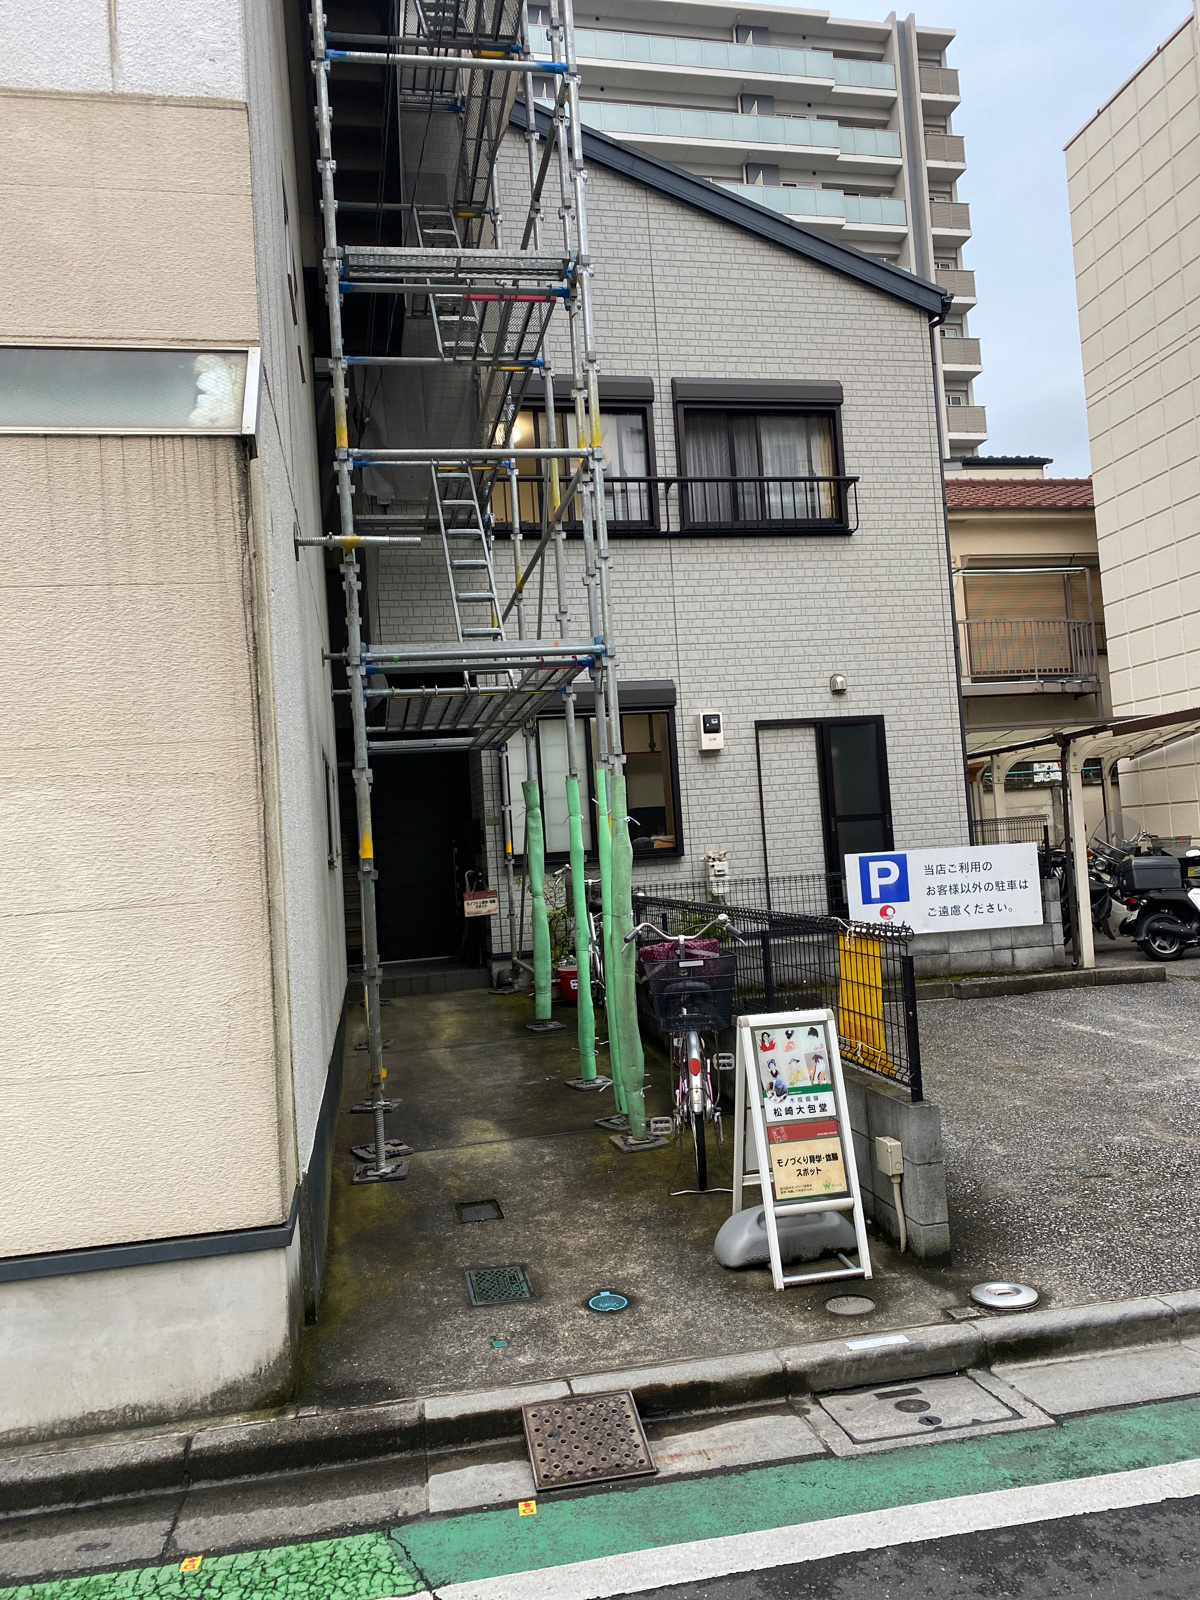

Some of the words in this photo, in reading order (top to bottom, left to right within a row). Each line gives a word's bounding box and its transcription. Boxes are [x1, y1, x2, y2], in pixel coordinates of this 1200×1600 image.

[923, 861, 993, 876] 当店ご利用の
[868, 860, 900, 899] P
[926, 879, 1029, 896] お客様以外の駐車は
[927, 902, 1013, 917] ご遠慮ください。
[796, 1166, 822, 1177] スポット
